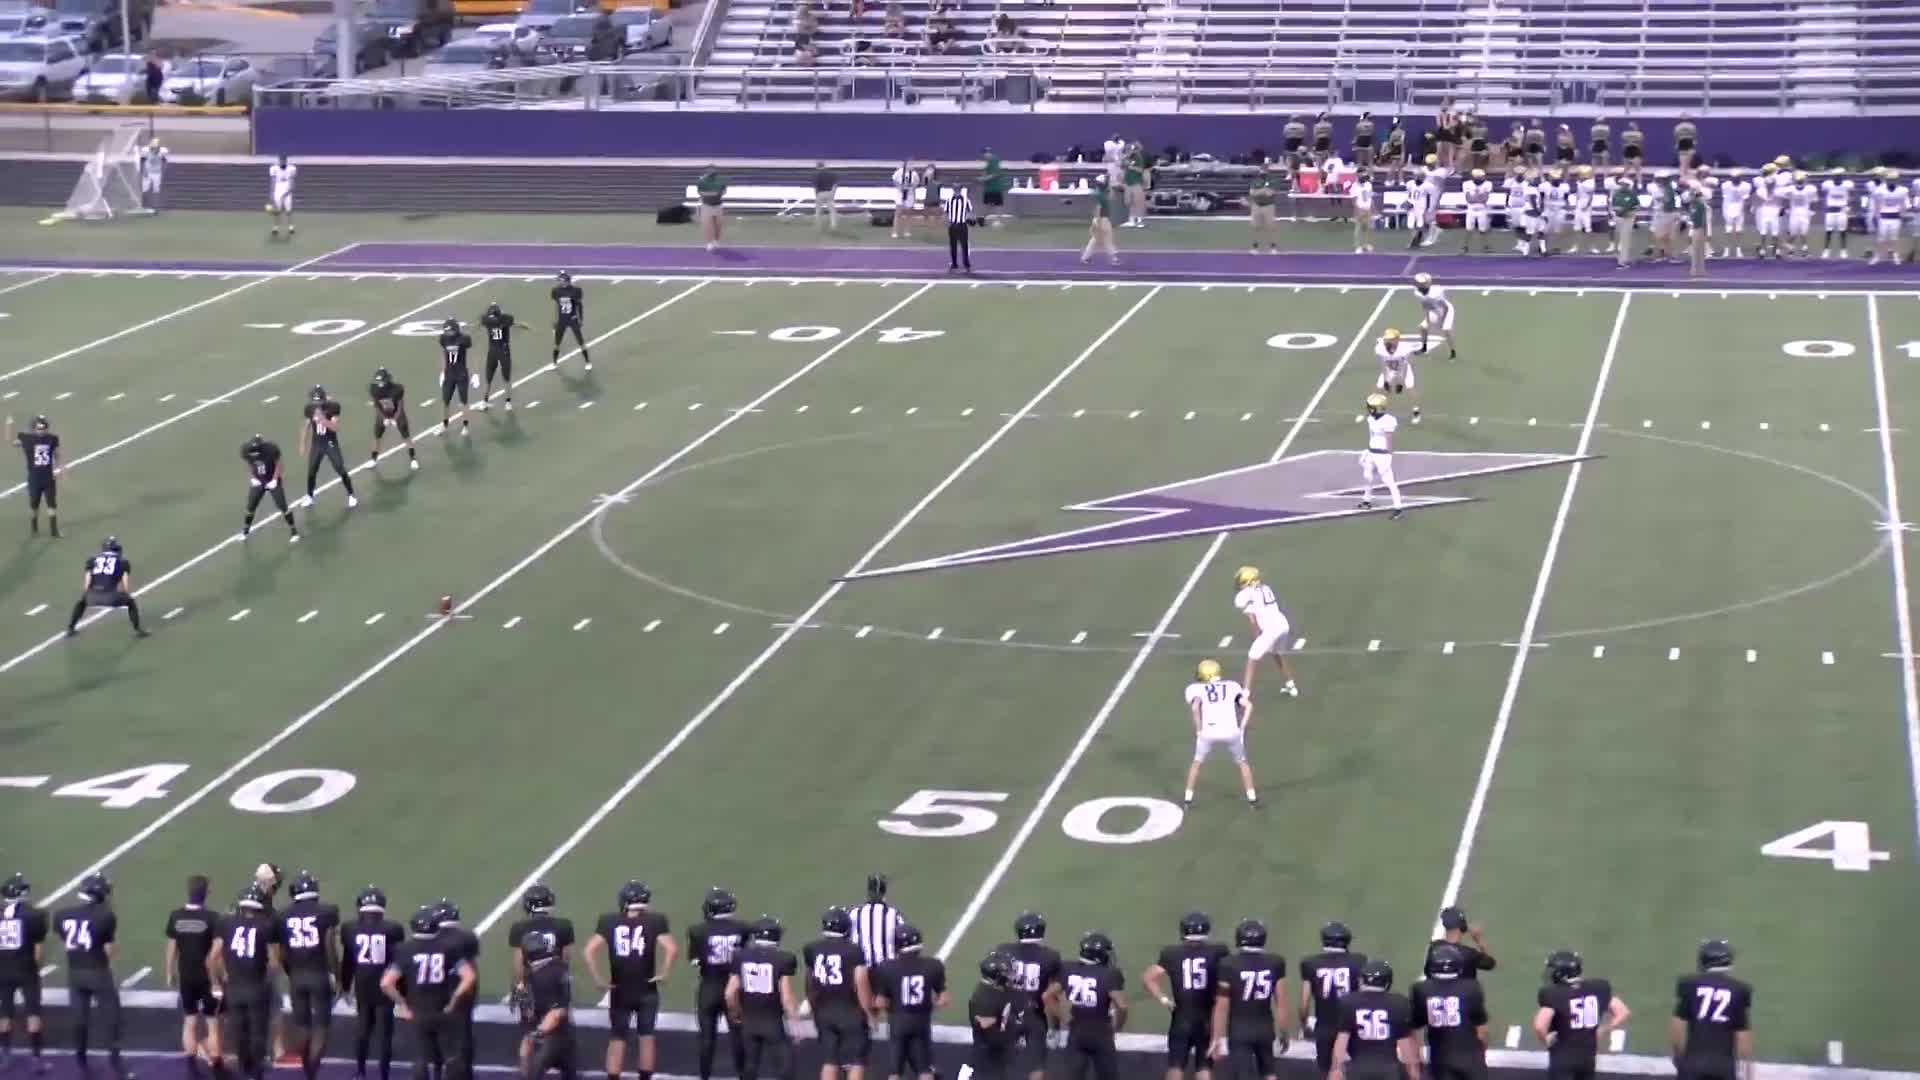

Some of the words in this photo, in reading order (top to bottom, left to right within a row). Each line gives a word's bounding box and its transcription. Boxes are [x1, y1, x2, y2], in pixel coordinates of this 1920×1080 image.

[92, 556, 117, 575] 33
[1205, 682, 1227, 703] 87
[62, 918, 93, 951] 24
[231, 926, 257, 958] 41
[286, 916, 320, 948] 35
[615, 924, 647, 957] 64
[355, 933, 387, 965] 20
[412, 952, 446, 985] 78
[814, 953, 843, 985] 43
[1182, 957, 1208, 991] 15
[901, 975, 925, 1006] 13
[1067, 974, 1098, 1008] 26
[1240, 969, 1273, 1002] 75
[1569, 994, 1599, 1029] 50
[1696, 985, 1733, 1023] 72
[1355, 1008, 1391, 1041] 56
